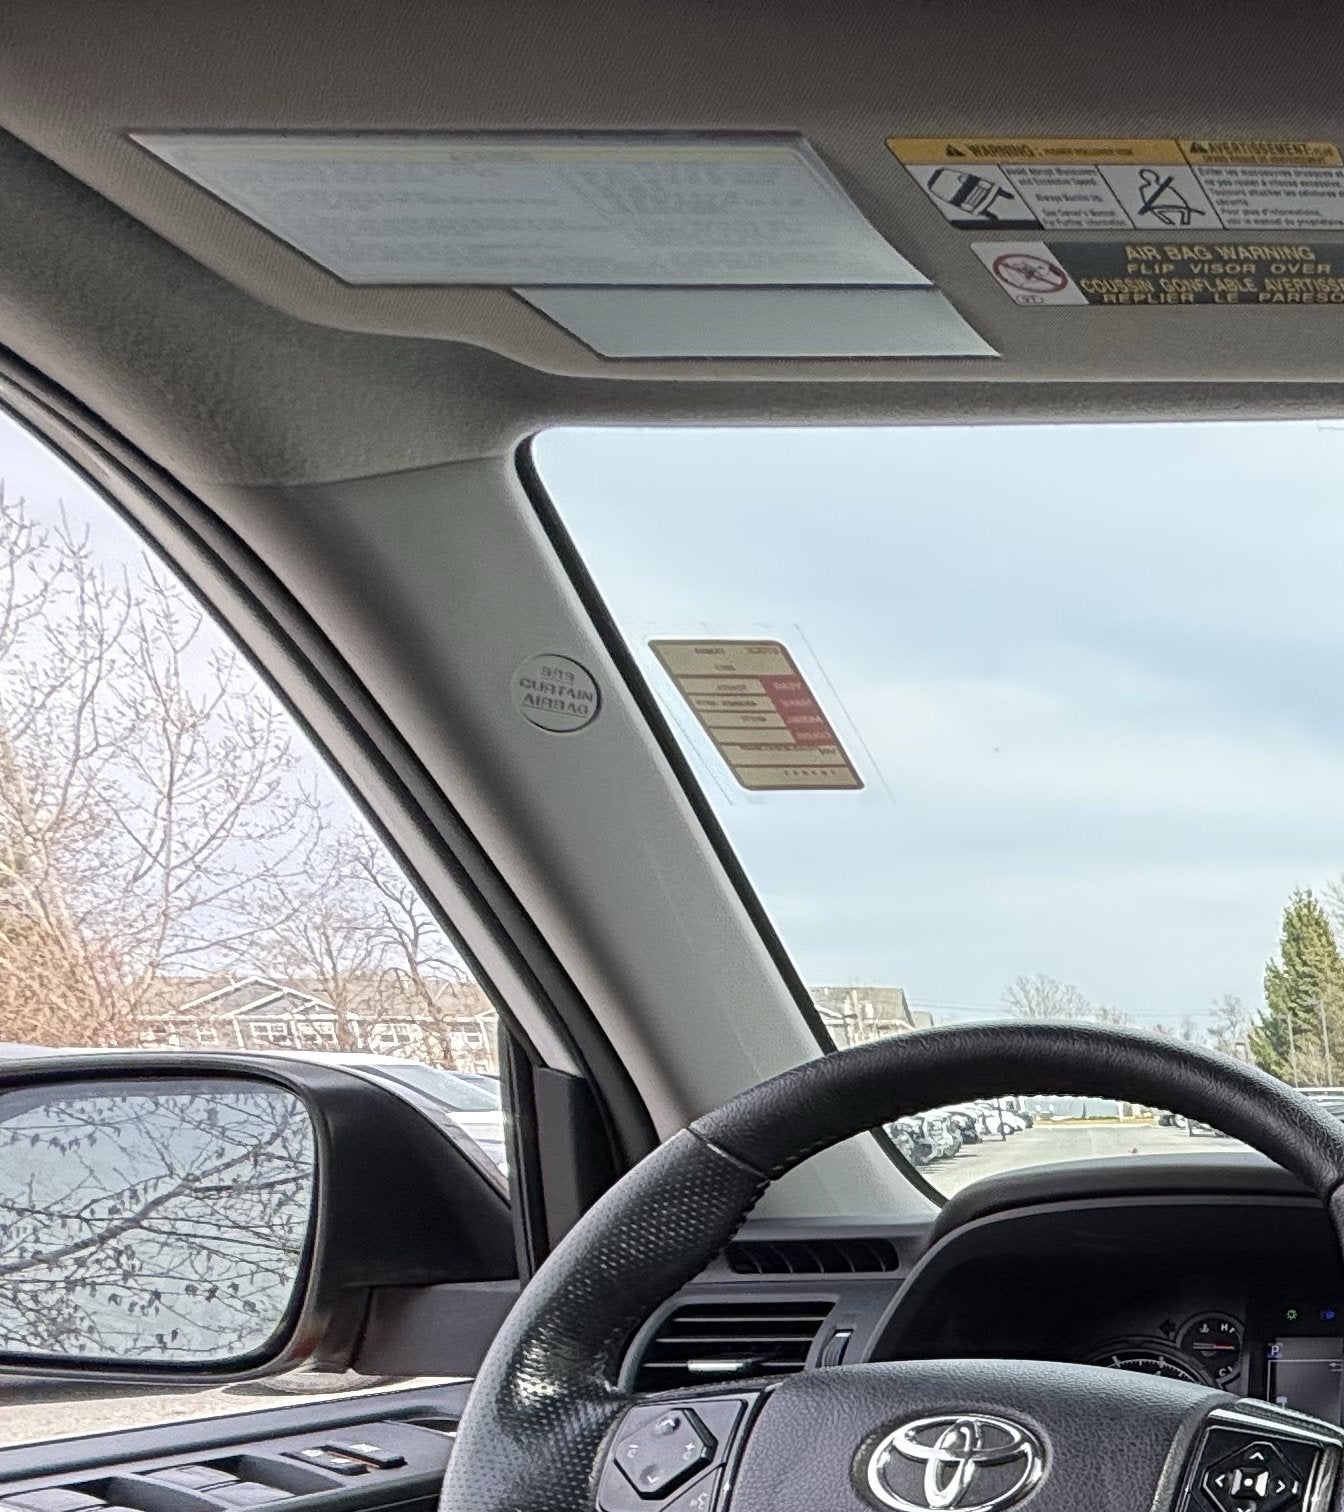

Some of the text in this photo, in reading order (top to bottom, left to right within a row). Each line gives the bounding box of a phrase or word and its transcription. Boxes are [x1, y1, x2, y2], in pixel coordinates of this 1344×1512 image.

[967, 143, 1036, 158] WARNING
[1125, 246, 1315, 262] AIR BAG WARNING
[1127, 263, 1331, 275] FLIP VISOR OVER
[1079, 278, 1152, 294] COUSSIN
[1160, 278, 1255, 294] GONFLABLE
[1103, 292, 1194, 303] REPLIER
[1214, 292, 1235, 303] LE
[519, 677, 594, 703] CURTAIN
[522, 692, 589, 715] AIRBAG
